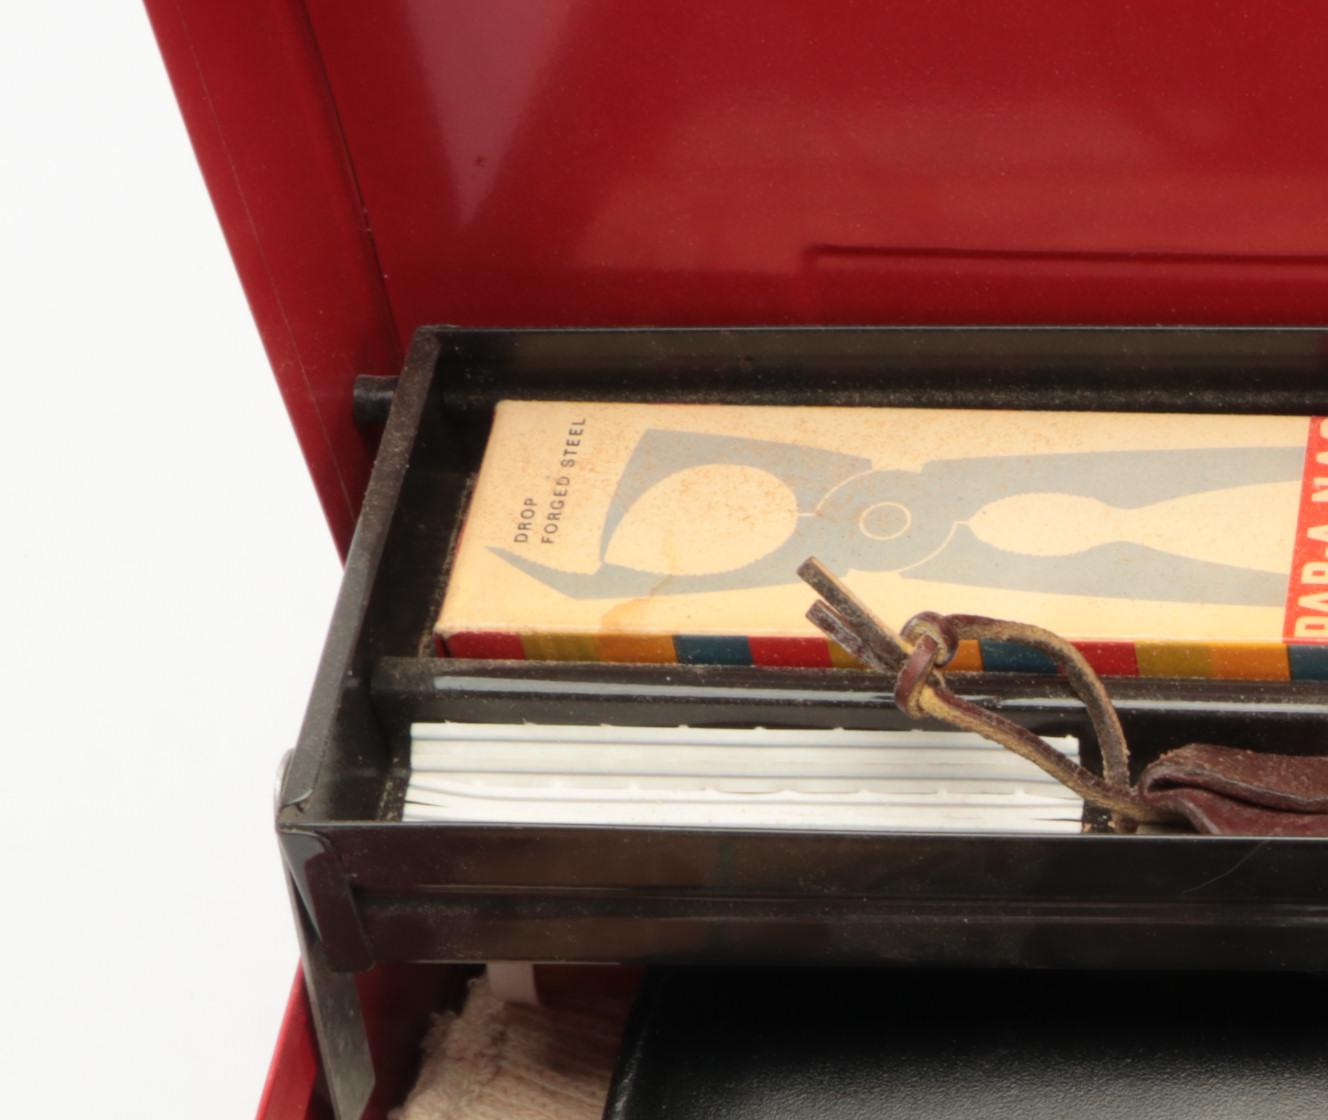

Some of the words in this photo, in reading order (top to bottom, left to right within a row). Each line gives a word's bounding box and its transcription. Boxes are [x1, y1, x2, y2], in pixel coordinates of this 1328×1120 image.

[513, 498, 537, 543] DROP
[541, 476, 571, 544] FORGED
[560, 418, 586, 468] STEEL
